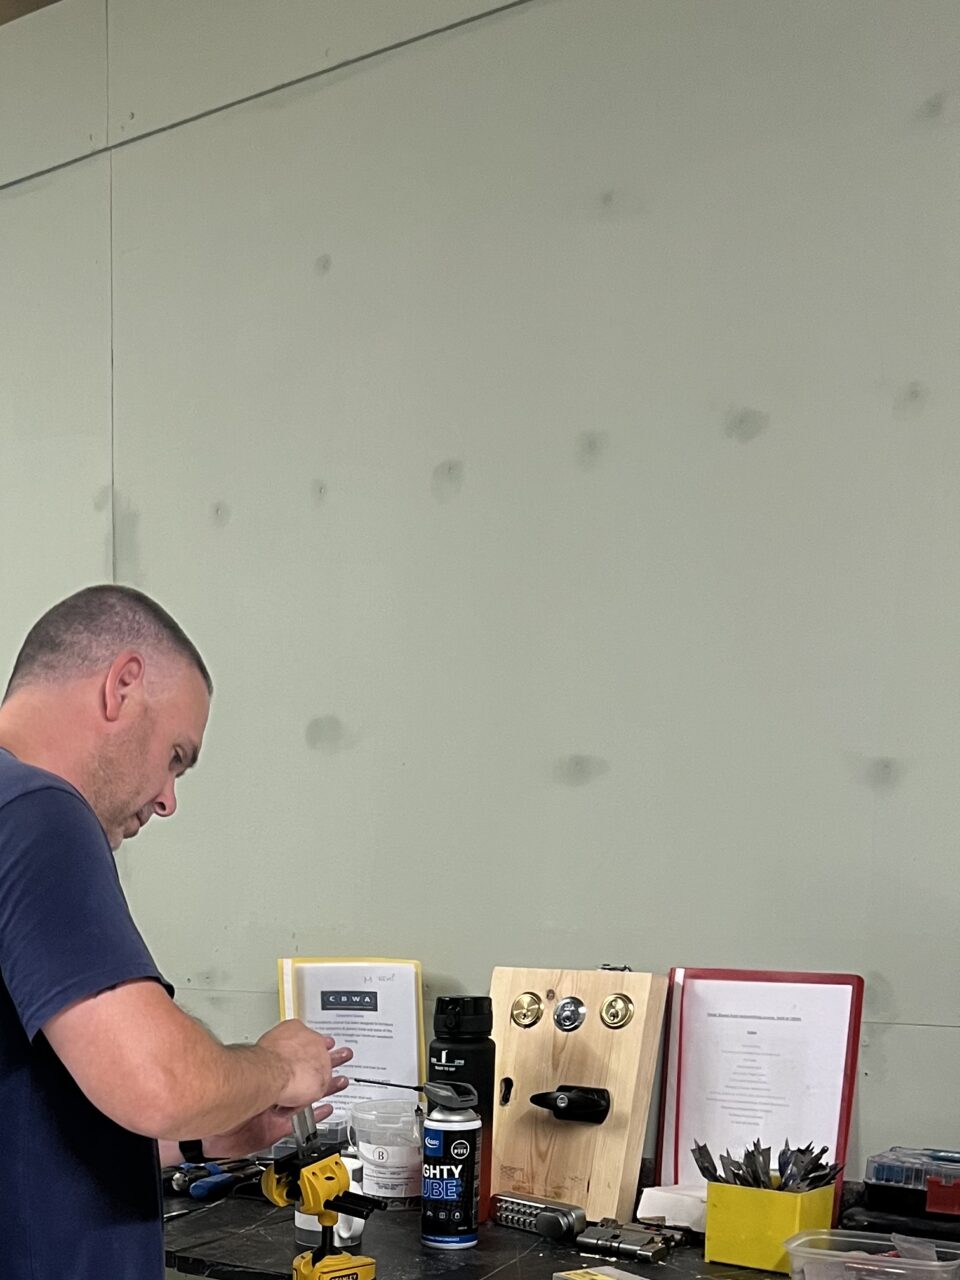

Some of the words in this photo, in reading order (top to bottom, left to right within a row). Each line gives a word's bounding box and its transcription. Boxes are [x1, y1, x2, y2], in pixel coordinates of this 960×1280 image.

[378, 1151, 384, 1160] B
[423, 1164, 463, 1179] GHTY
[423, 1180, 457, 1199] UBE
